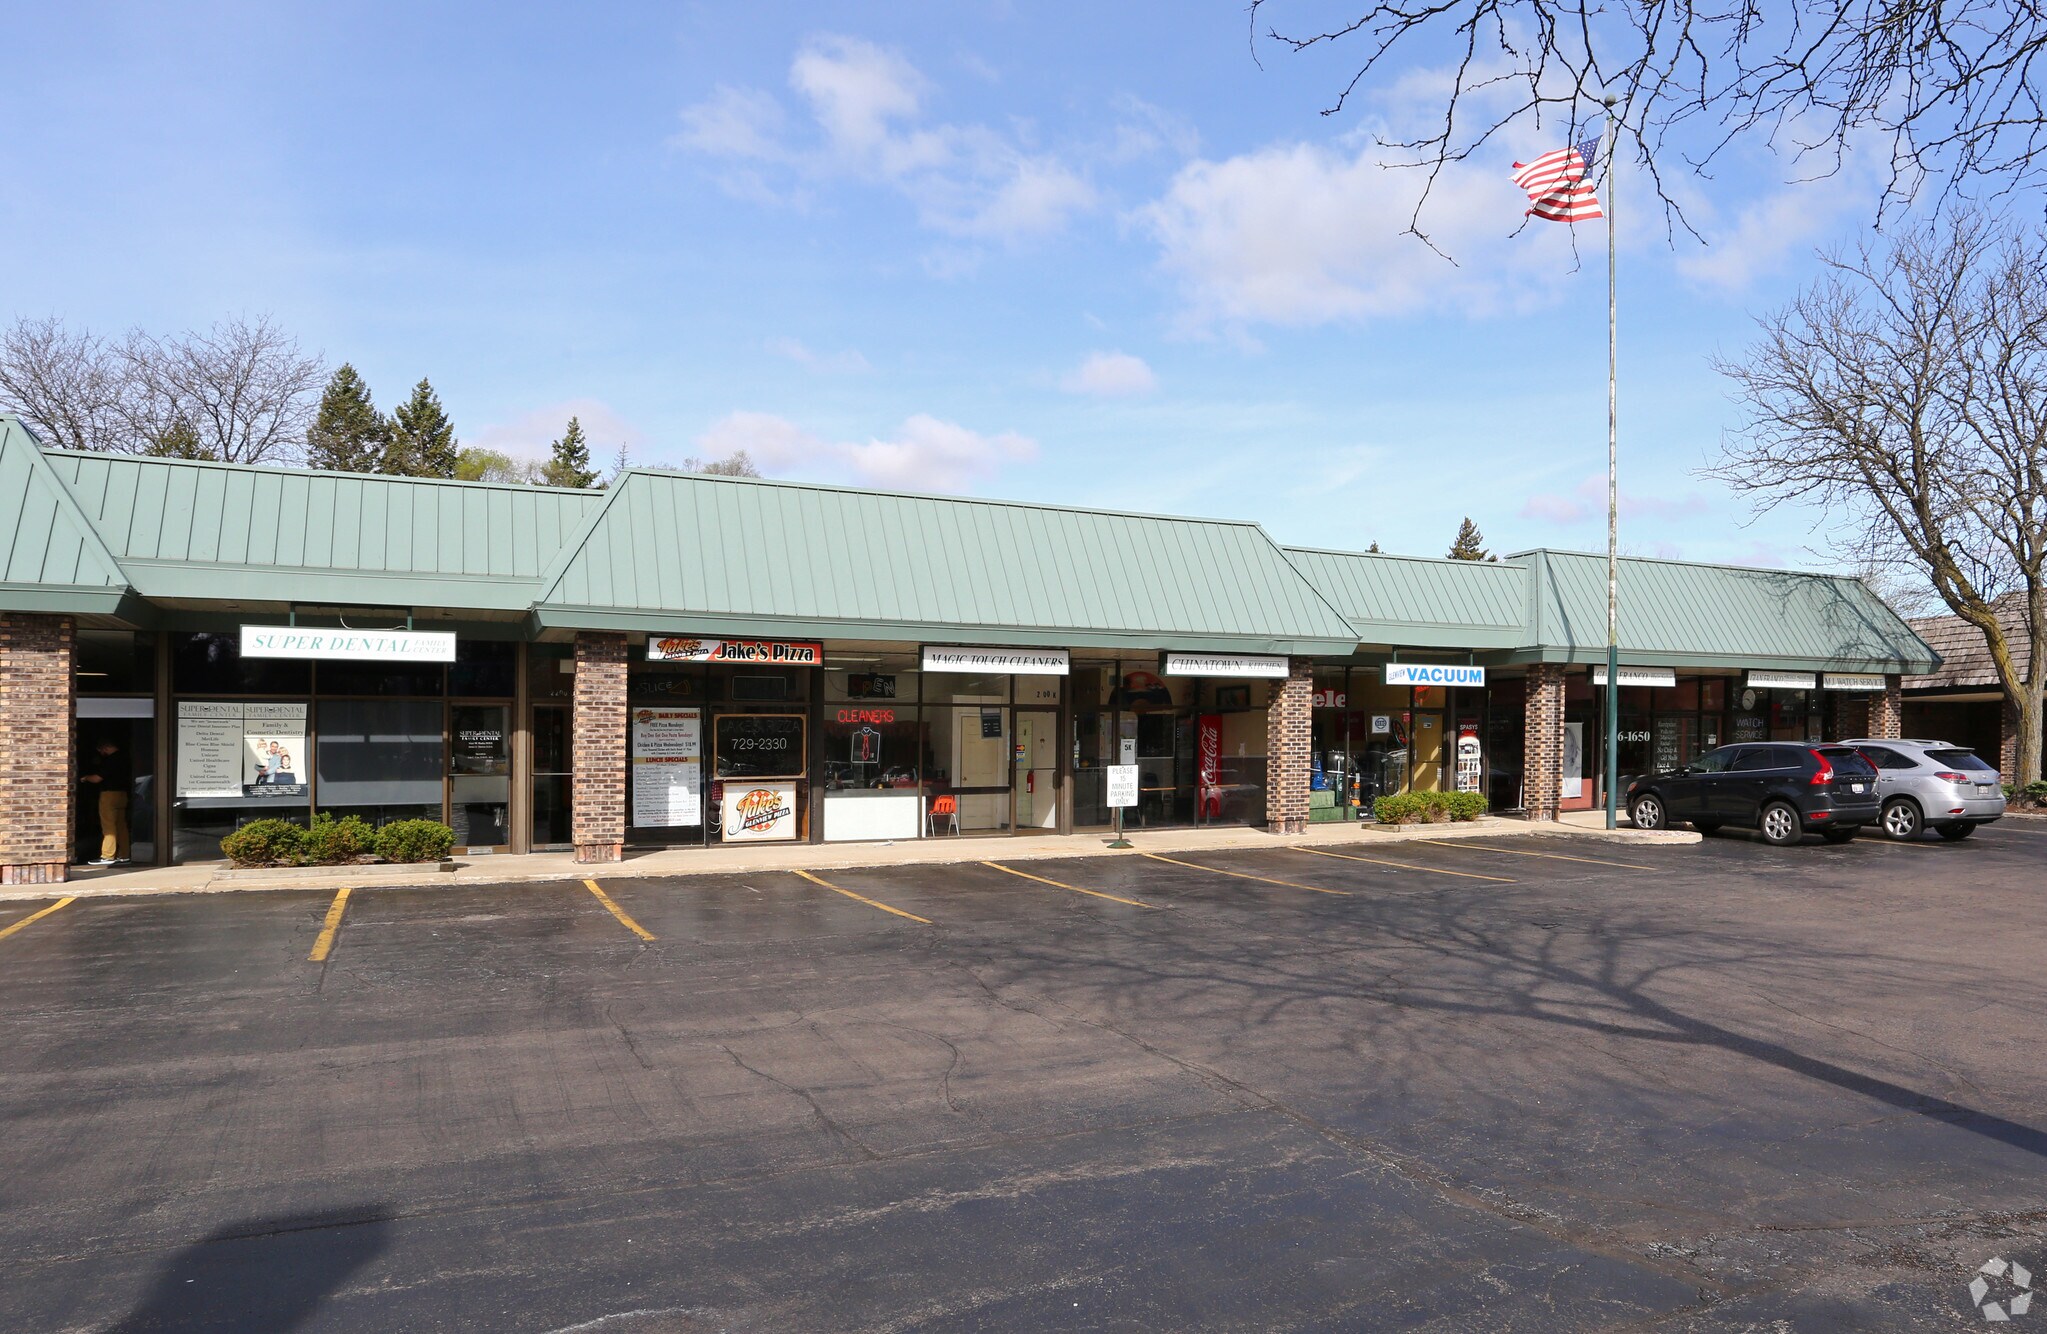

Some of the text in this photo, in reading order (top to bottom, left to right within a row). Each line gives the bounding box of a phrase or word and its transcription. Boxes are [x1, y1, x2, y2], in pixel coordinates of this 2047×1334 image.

[252, 634, 411, 653] SUPER DENTAL
[414, 639, 447, 647] FAMILY
[656, 638, 702, 657] Jake's
[412, 646, 447, 654] CENTER
[716, 642, 814, 662] Jake's Pizza
[930, 653, 1064, 667] MAGIC TOUCH CLEANERS
[1171, 658, 1282, 672] CHINATOWN KITCHEN
[1406, 667, 1482, 683] VACUUM
[1619, 671, 1649, 680] FRANCO
[1837, 678, 1858, 686] WATCH
[1859, 678, 1884, 687] SERVICE
[180, 705, 241, 713] SUPER DENTAL
[838, 709, 895, 723] CLEANERS
[1736, 717, 1764, 728] WATCH
[1604, 730, 1651, 742] 6-1650
[1735, 729, 1762, 739] SERVICE
[731, 737, 788, 750] 729-2330
[1112, 782, 1133, 790] MINUTE
[727, 790, 783, 835] Jake's
[745, 807, 790, 828] GLENVIEW PIZZA
